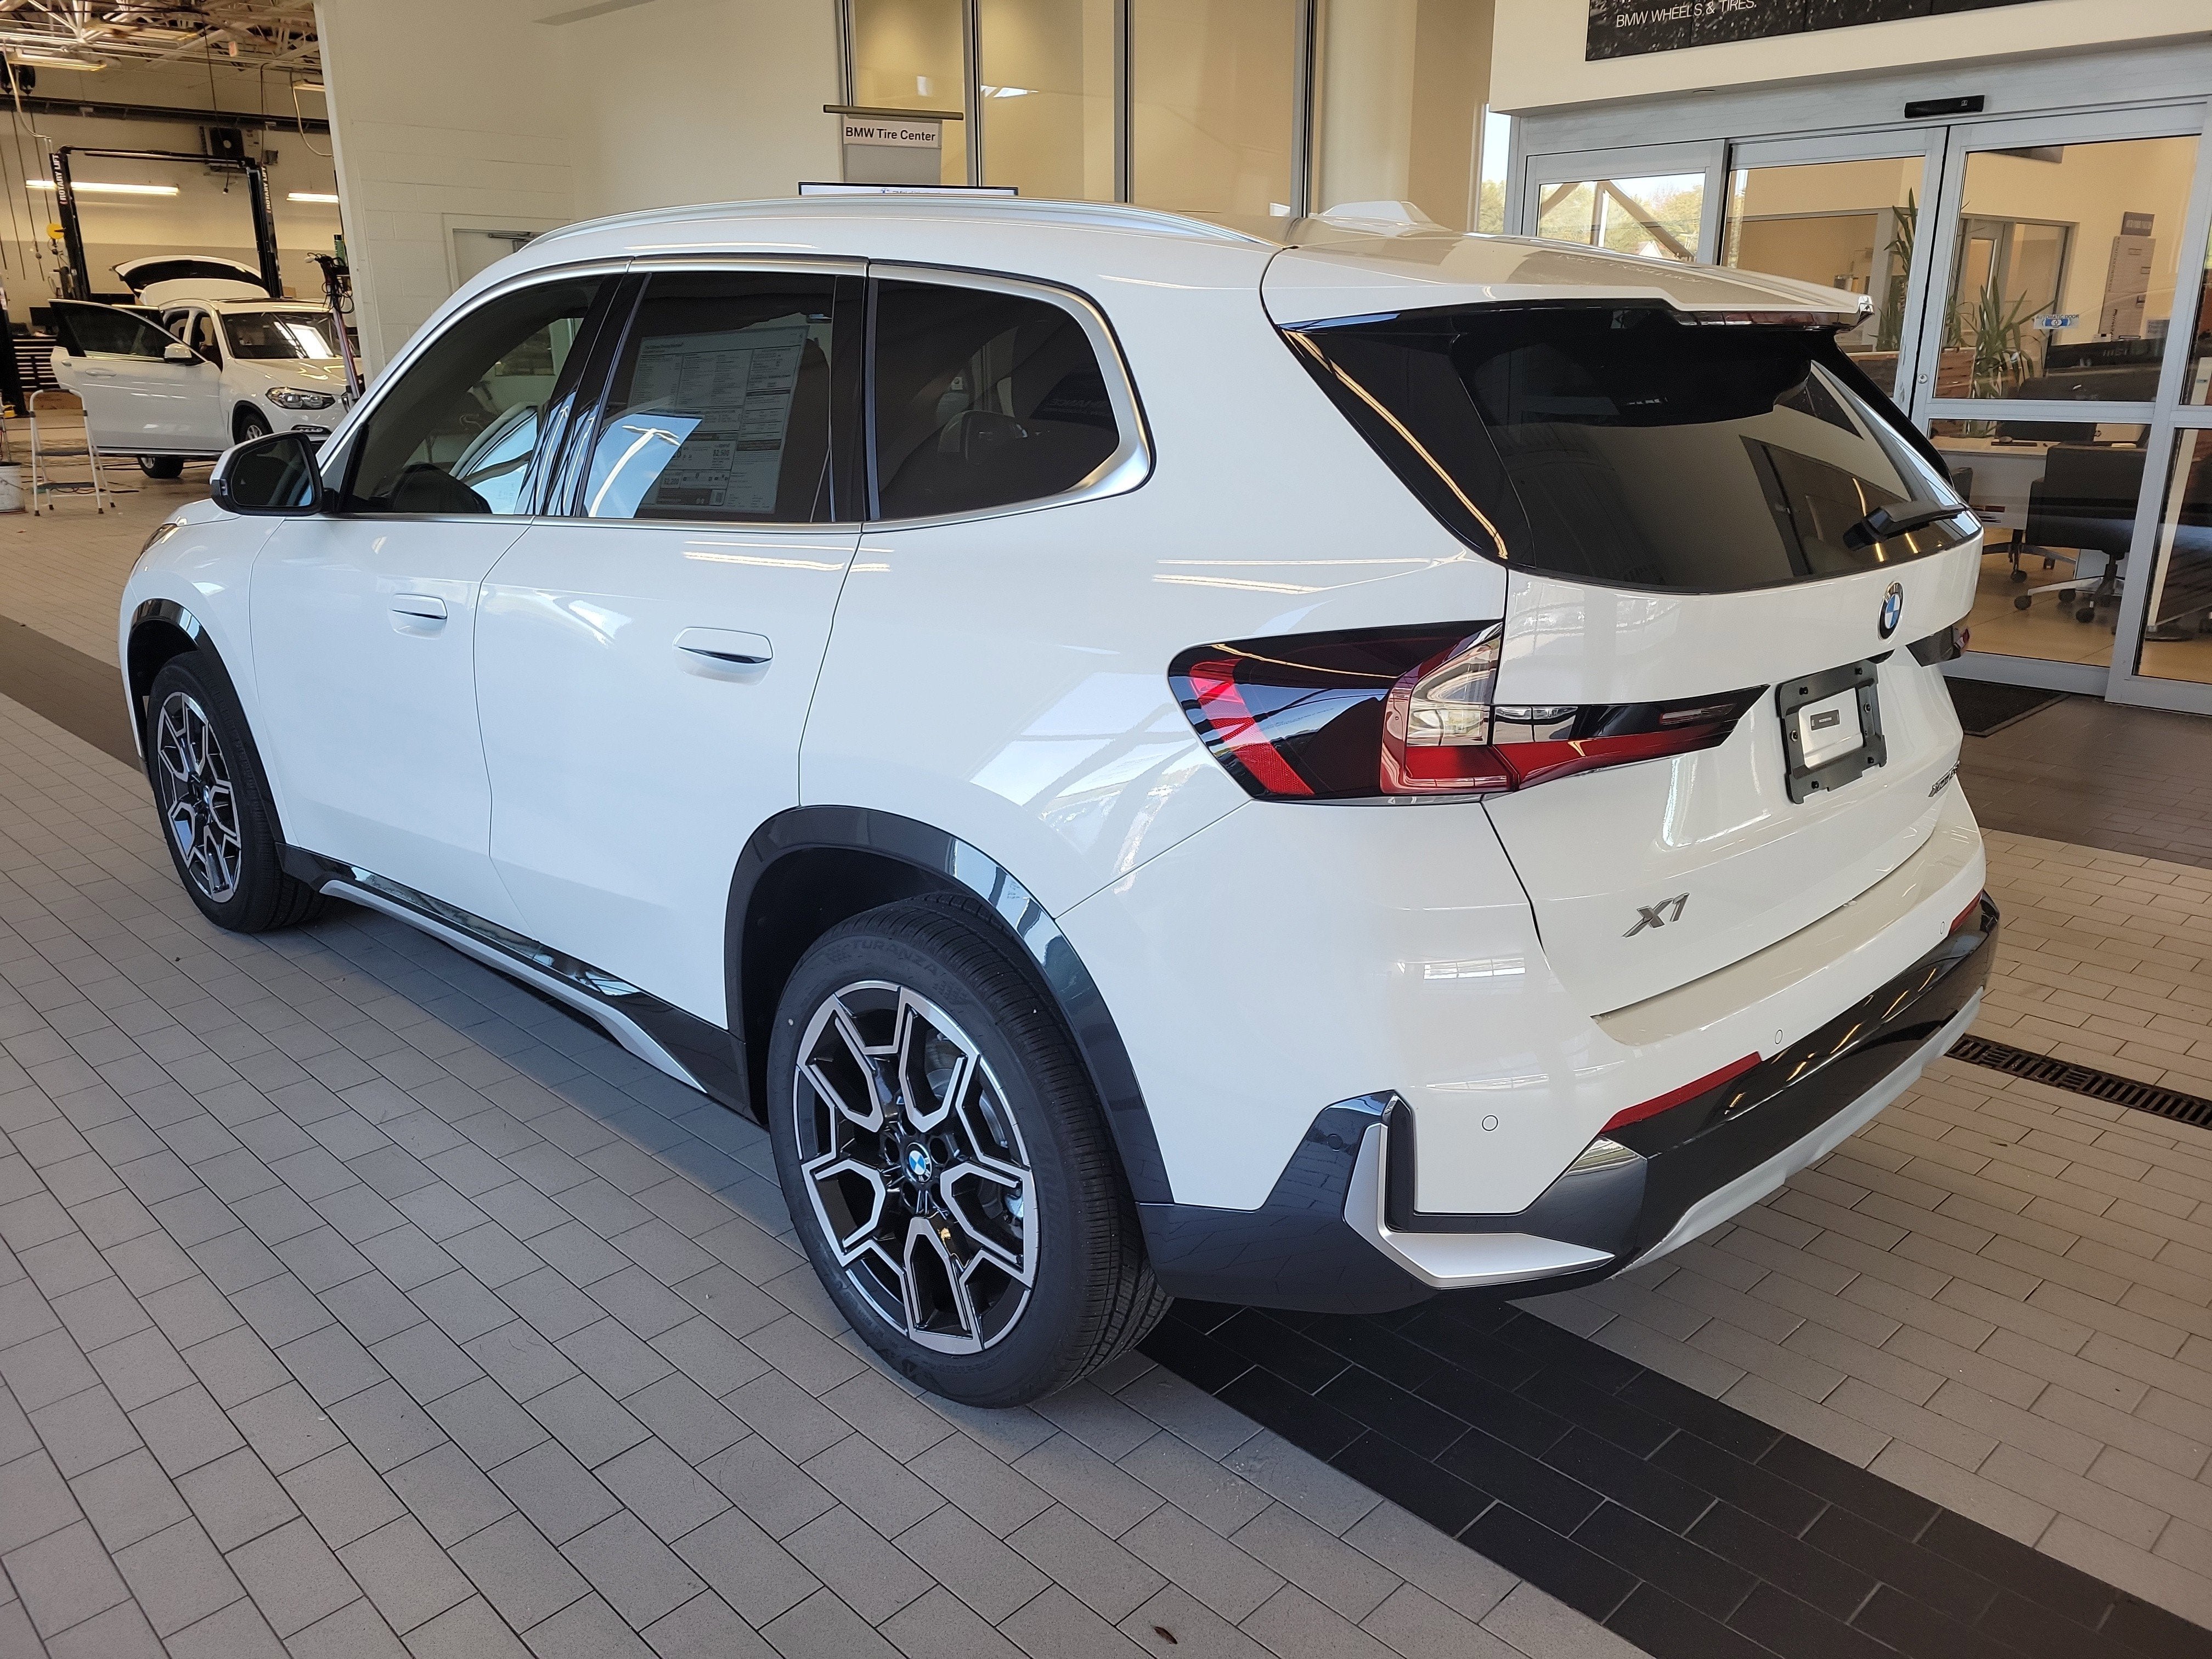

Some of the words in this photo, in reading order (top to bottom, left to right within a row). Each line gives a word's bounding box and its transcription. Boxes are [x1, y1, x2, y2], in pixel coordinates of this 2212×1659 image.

[1616, 11, 1648, 27] BMW
[1651, 3, 1702, 22] WHEELS
[1706, 1, 1715, 15] &
[846, 127, 874, 138] BMW
[877, 128, 898, 139] Tire
[900, 130, 936, 141] Center
[52, 154, 61, 170] LIFT
[55, 171, 66, 200] ROTARY
[1621, 892, 1690, 938] X1
